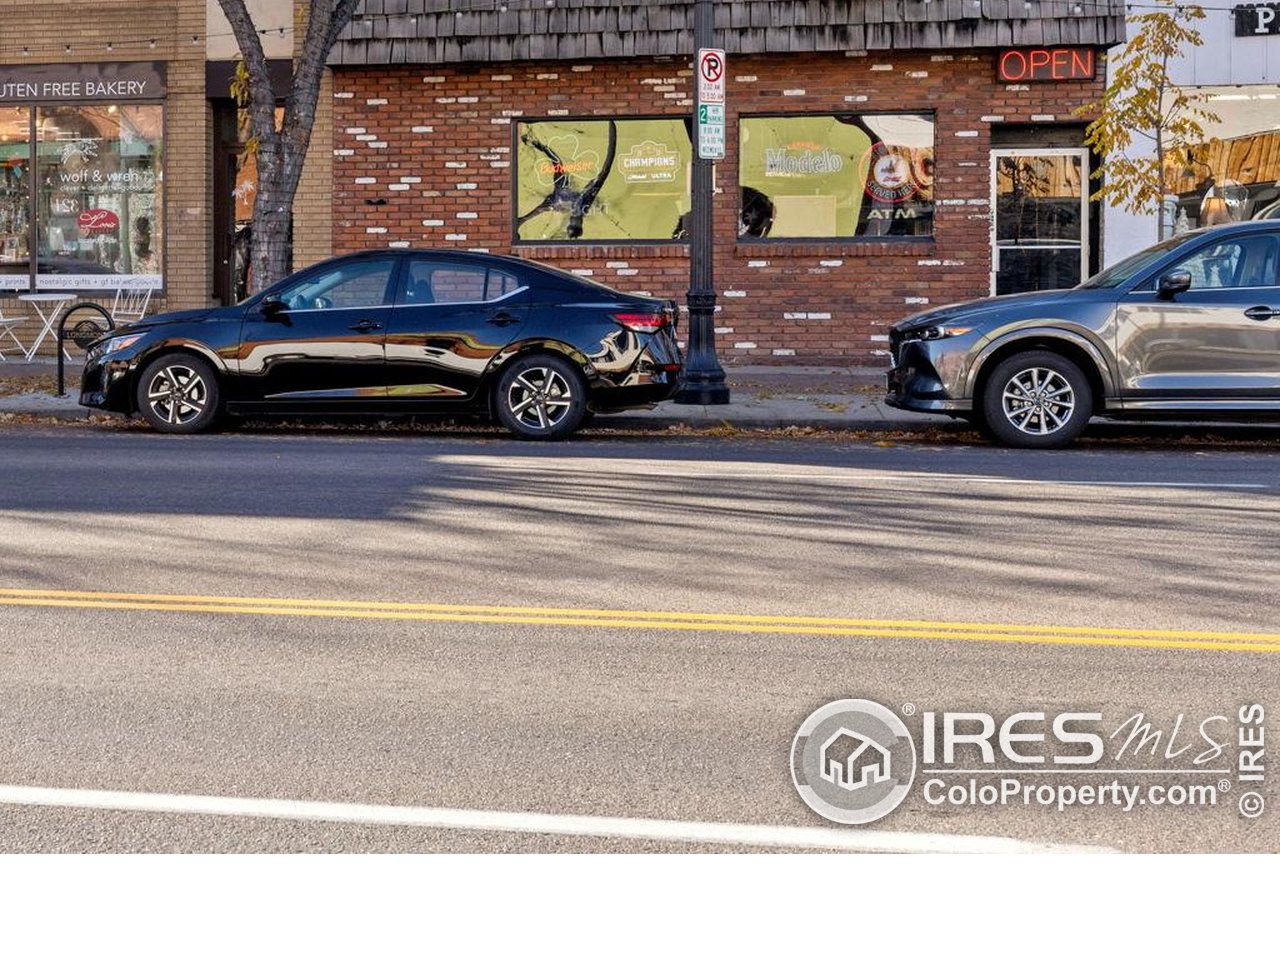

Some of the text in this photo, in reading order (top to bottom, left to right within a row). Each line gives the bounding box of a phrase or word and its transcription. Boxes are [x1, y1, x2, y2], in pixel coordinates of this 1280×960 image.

[1001, 50, 1093, 80] OPEN
[43, 82, 81, 96] FREE
[85, 80, 147, 96] BAKERY
[700, 107, 706, 122] 2
[623, 156, 676, 168] CHAMPIONS
[765, 148, 843, 173] Modelo
[60, 169, 139, 182] wolf & wren
[866, 208, 918, 220] ATM
